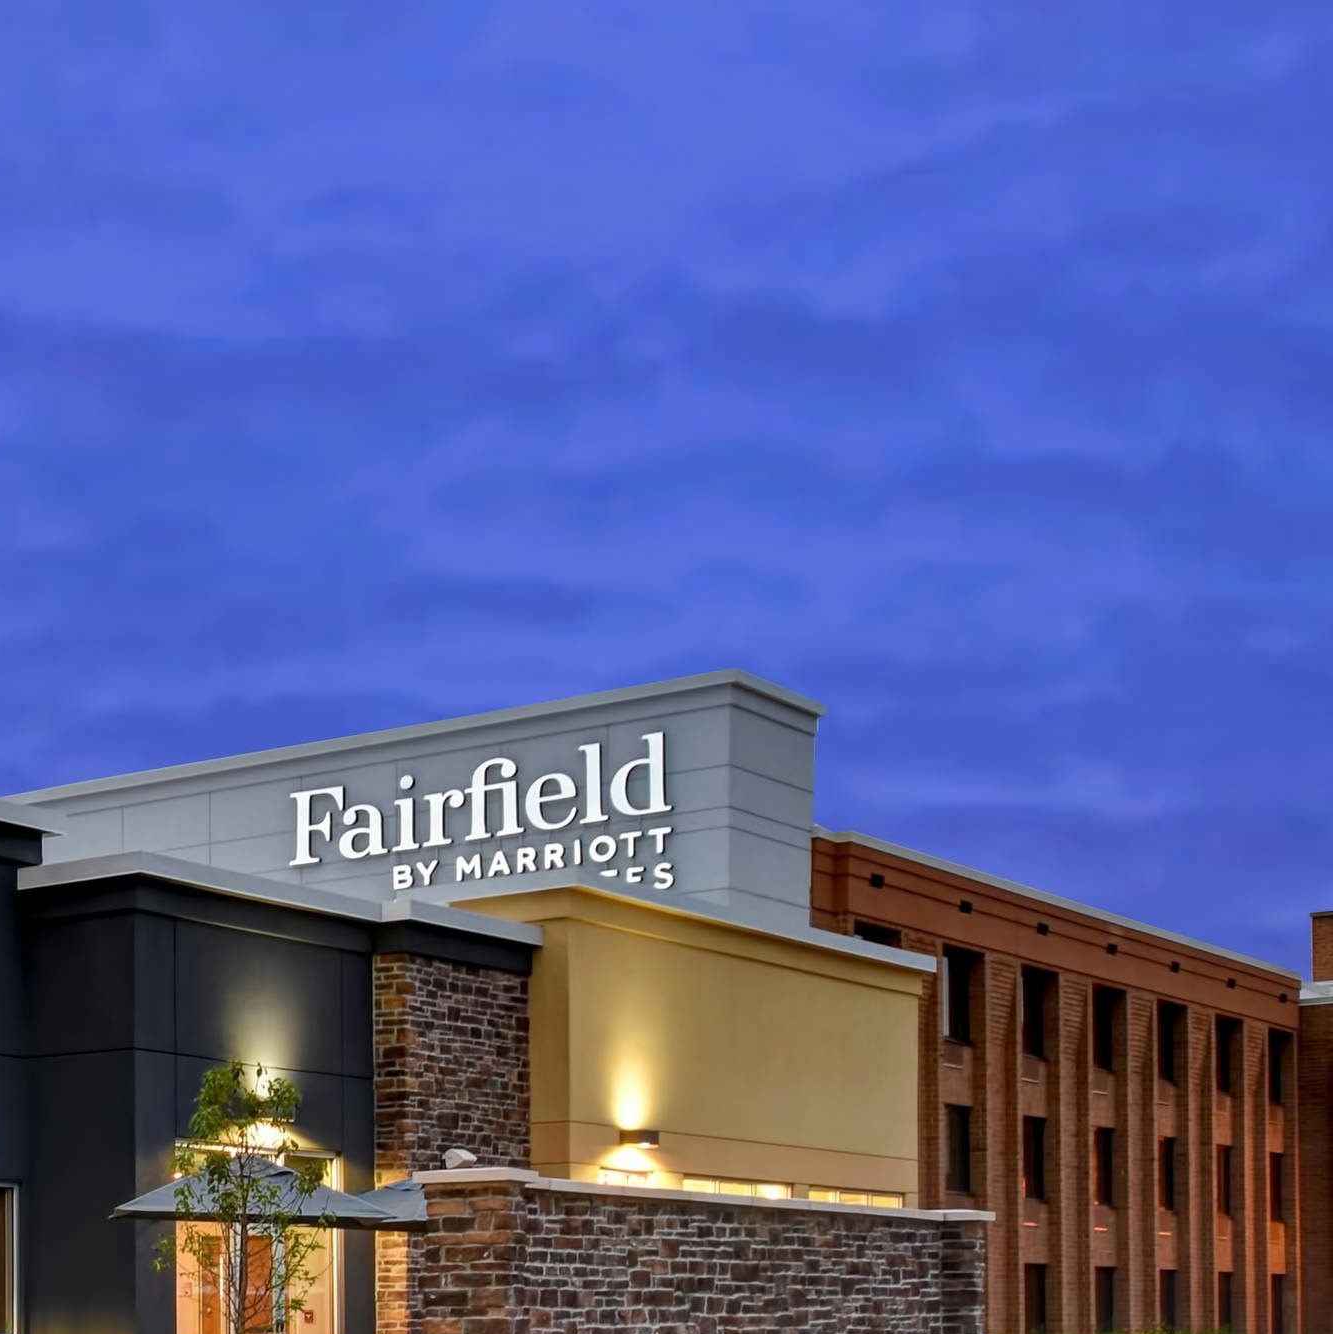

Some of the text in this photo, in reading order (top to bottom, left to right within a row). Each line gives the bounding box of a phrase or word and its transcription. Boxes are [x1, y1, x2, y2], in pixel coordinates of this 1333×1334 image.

[289, 731, 674, 867] Fairfield
[393, 859, 439, 890] BY
[455, 827, 673, 882] MARRIOTT
